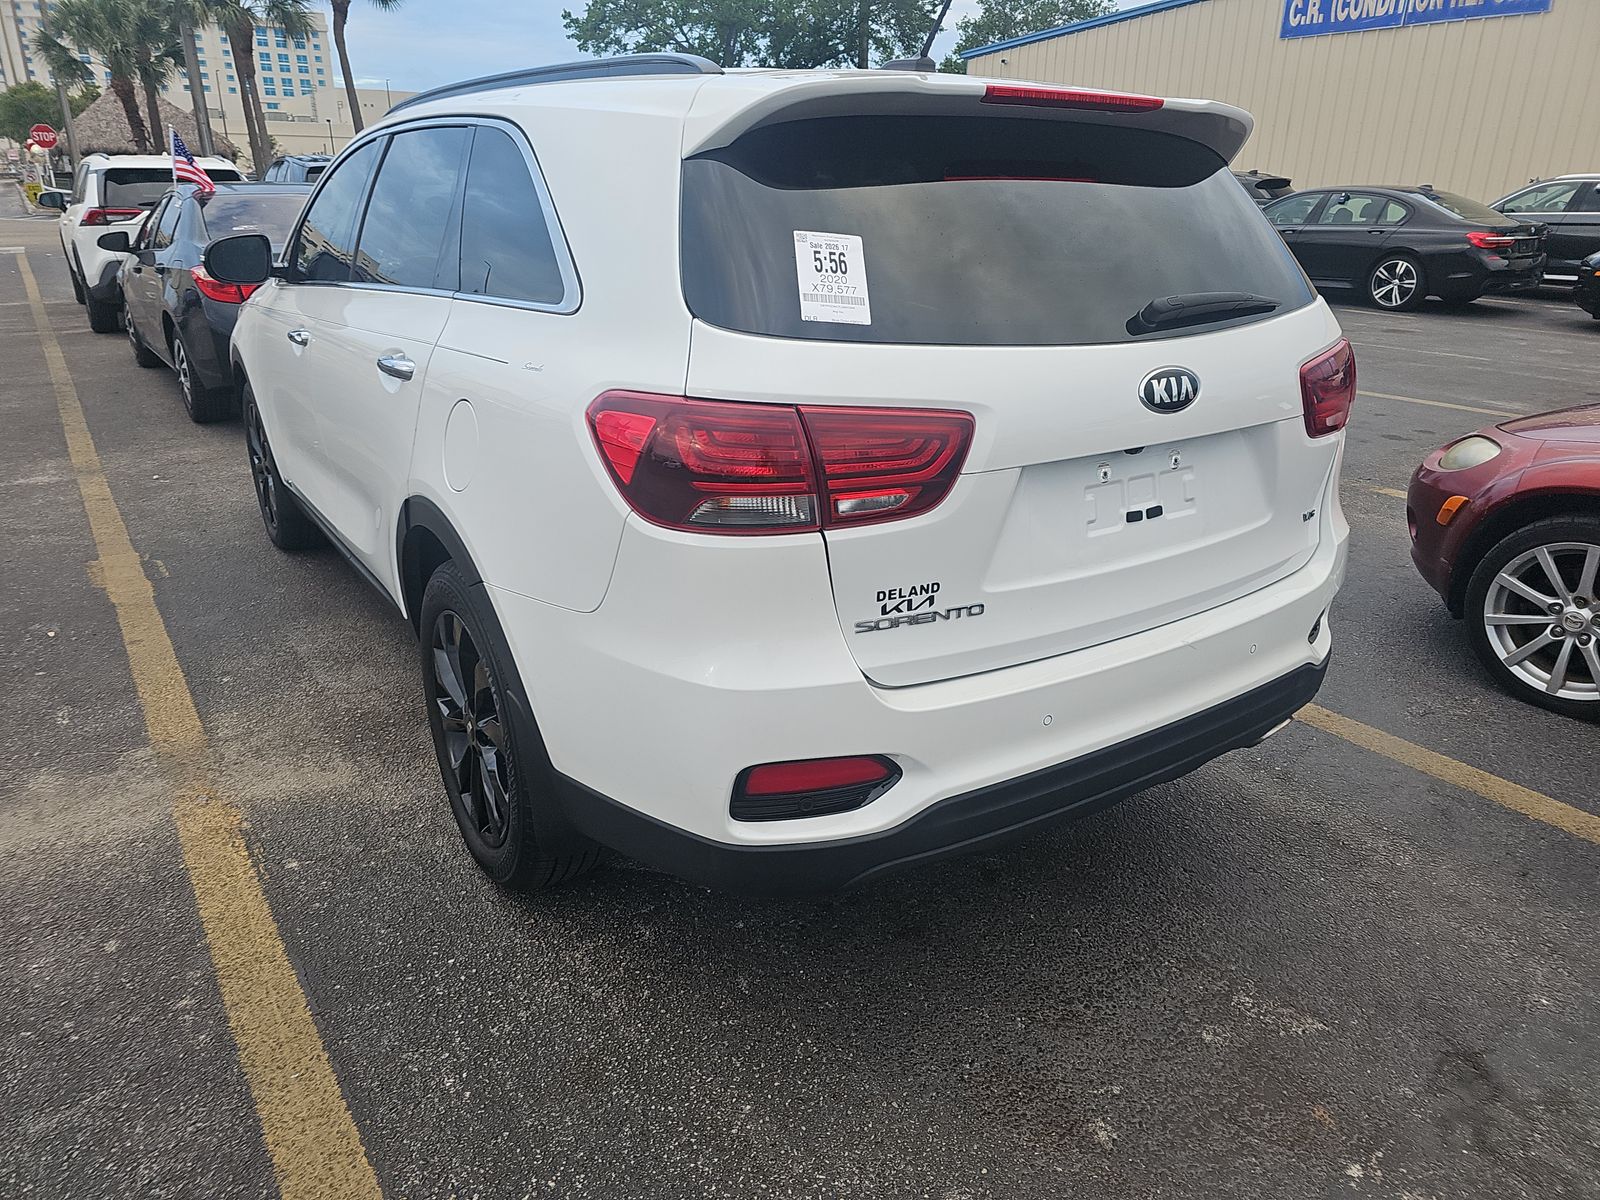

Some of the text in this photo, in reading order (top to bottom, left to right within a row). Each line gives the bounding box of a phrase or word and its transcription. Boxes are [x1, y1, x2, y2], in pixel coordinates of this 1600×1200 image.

[32, 131, 56, 142] STOP
[809, 241, 823, 250] Sale
[813, 250, 848, 275] 5:56
[811, 282, 857, 295] X79,577
[819, 273, 848, 285] 2020
[1150, 375, 1195, 404] KIA
[876, 581, 941, 602] DELAND
[880, 594, 935, 616] KIA
[854, 603, 985, 634] SORENTO
